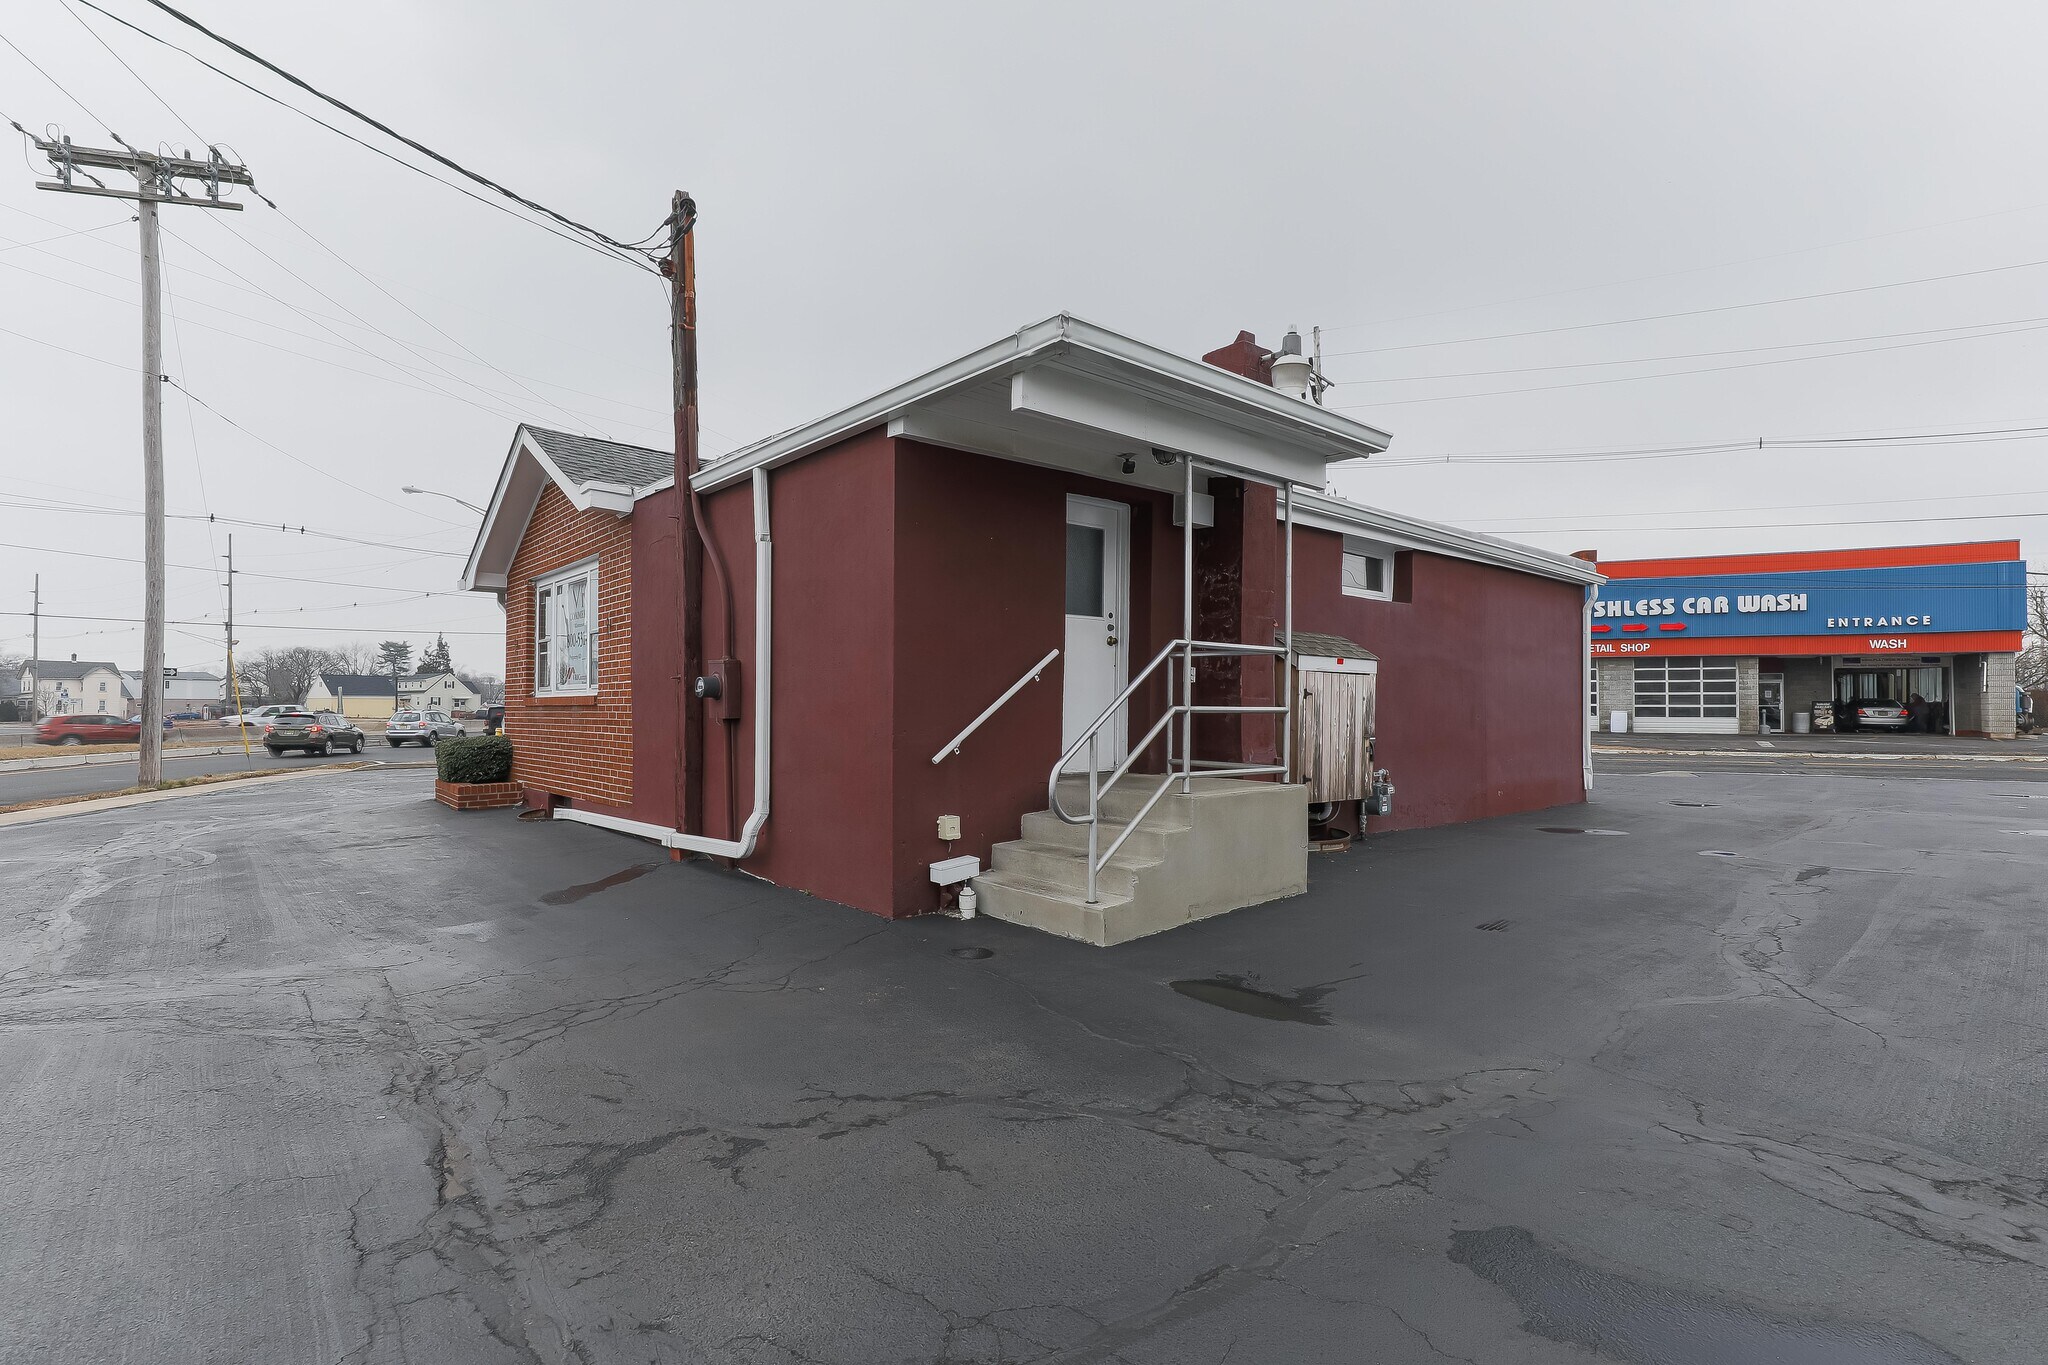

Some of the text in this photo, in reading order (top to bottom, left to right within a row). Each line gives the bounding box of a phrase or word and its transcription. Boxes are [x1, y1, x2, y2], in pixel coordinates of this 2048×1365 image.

[1594, 593, 1807, 617] SHLESS CAR WASH
[1827, 615, 1931, 628] ENTRANCE
[1620, 643, 1651, 652] SHOP
[1869, 639, 1907, 649] WASH
